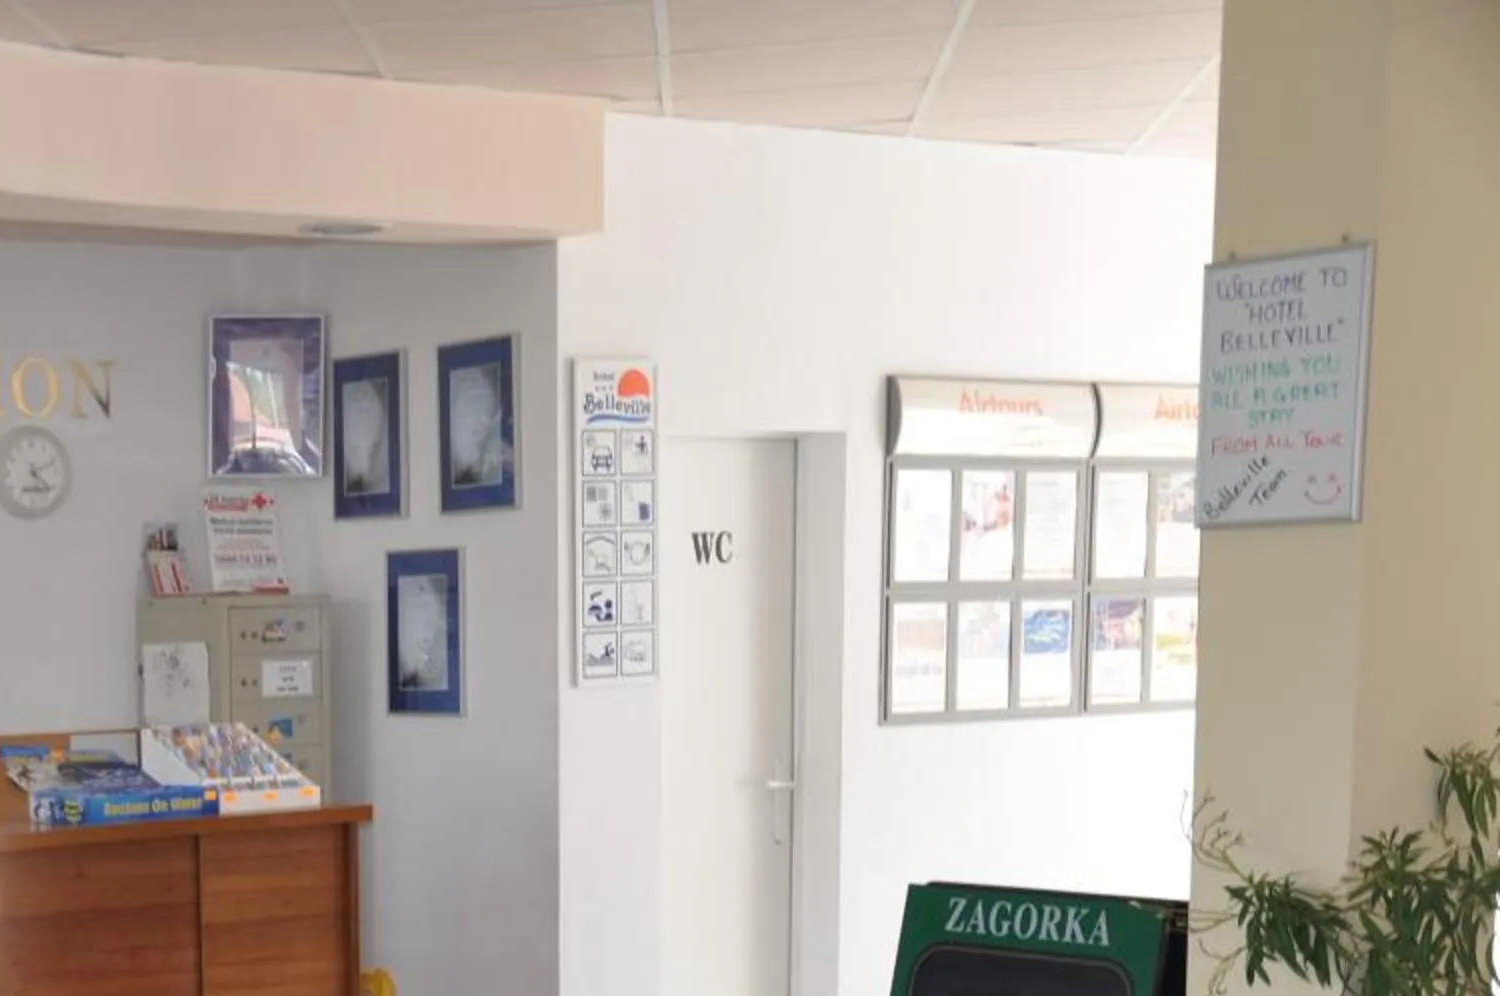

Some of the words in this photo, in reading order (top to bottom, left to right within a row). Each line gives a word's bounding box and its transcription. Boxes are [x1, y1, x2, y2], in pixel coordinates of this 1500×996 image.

[1216, 271, 1307, 301] WELCOME
[1319, 265, 1349, 289] TO
[1211, 357, 1291, 387] WISHING
[1301, 352, 1342, 375] YOU
[583, 391, 652, 416] Belleville
[1209, 387, 1246, 411] ALL
[1248, 406, 1297, 430] STAY
[690, 529, 734, 566] WC
[944, 896, 1112, 947] ZAGORKA
